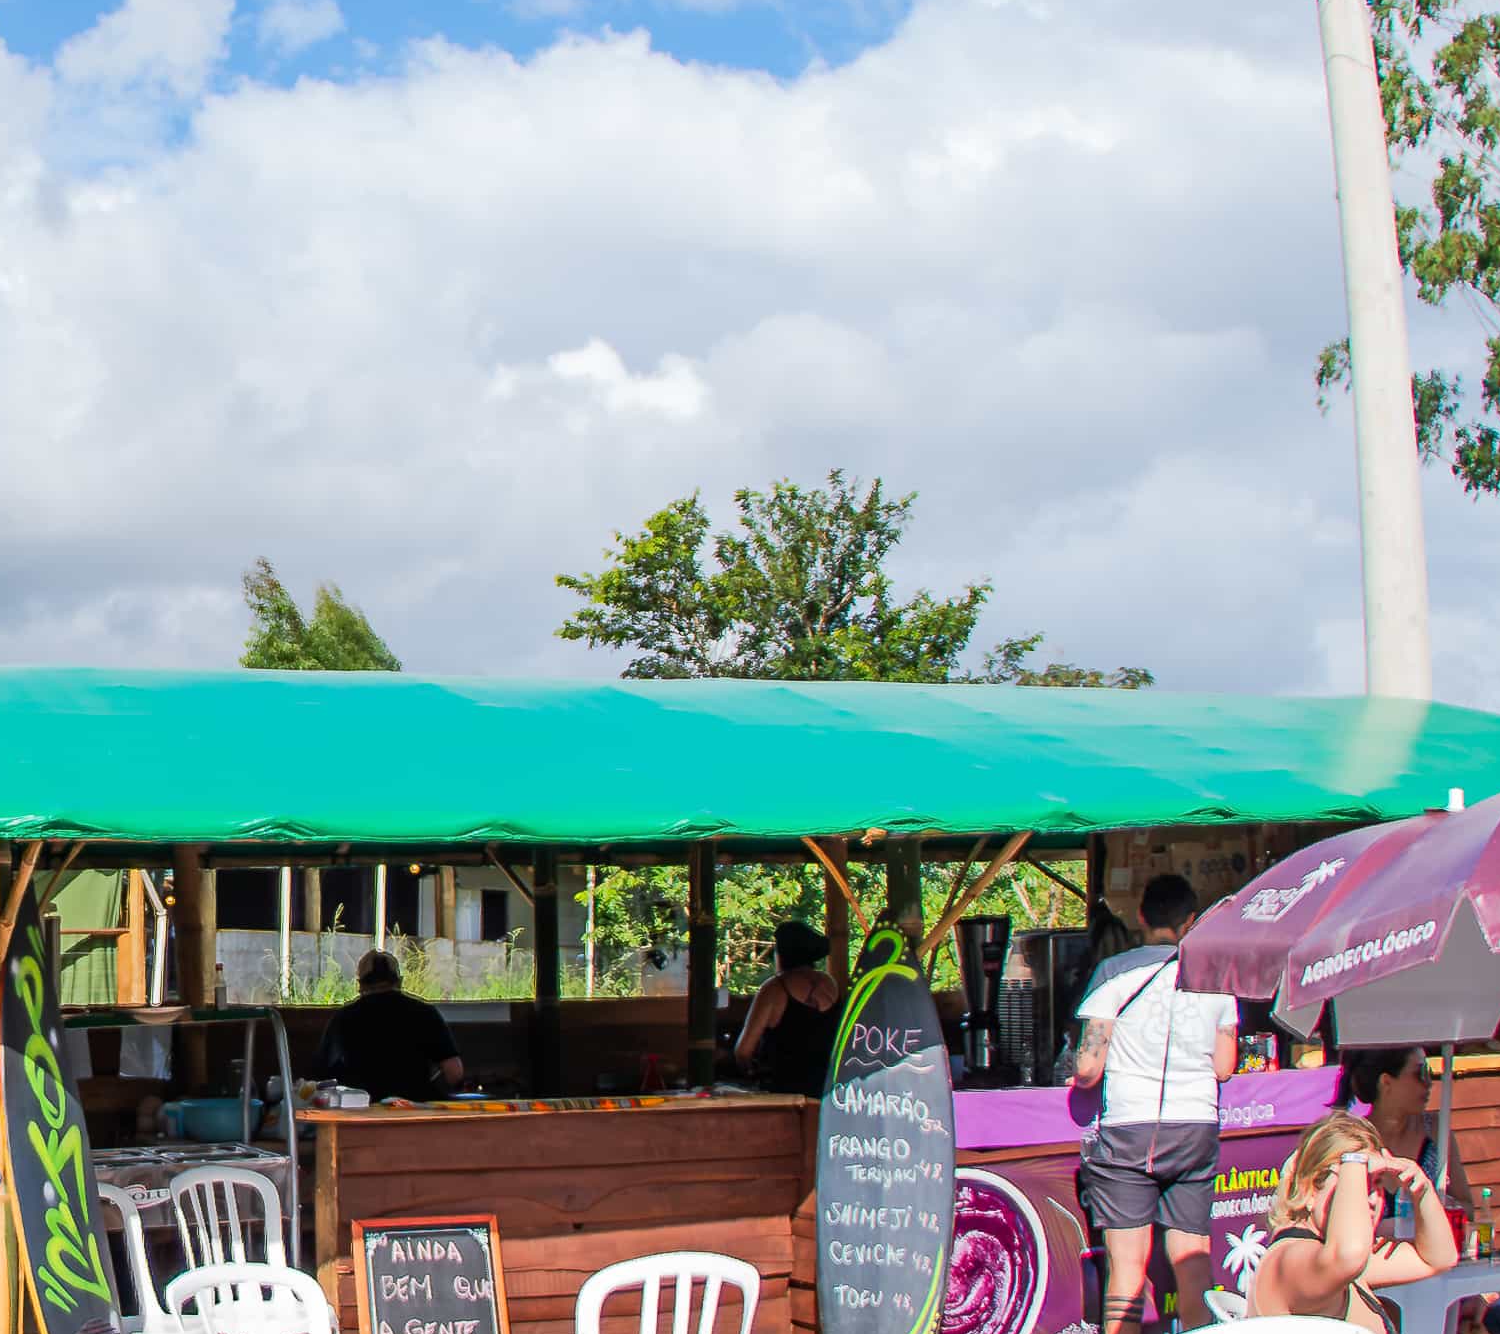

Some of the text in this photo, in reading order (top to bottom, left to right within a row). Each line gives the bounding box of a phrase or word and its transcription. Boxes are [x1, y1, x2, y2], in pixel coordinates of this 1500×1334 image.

[1300, 920, 1437, 987] AGROECOLÓGICO
[851, 1023, 924, 1059] POKE
[832, 1082, 930, 1123] CAMARÃO
[828, 1134, 911, 1162] FRANGO
[1213, 1166, 1281, 1195] TLÂNTICA
[380, 1274, 433, 1302] BEM
[834, 1283, 883, 1308] TOFU
